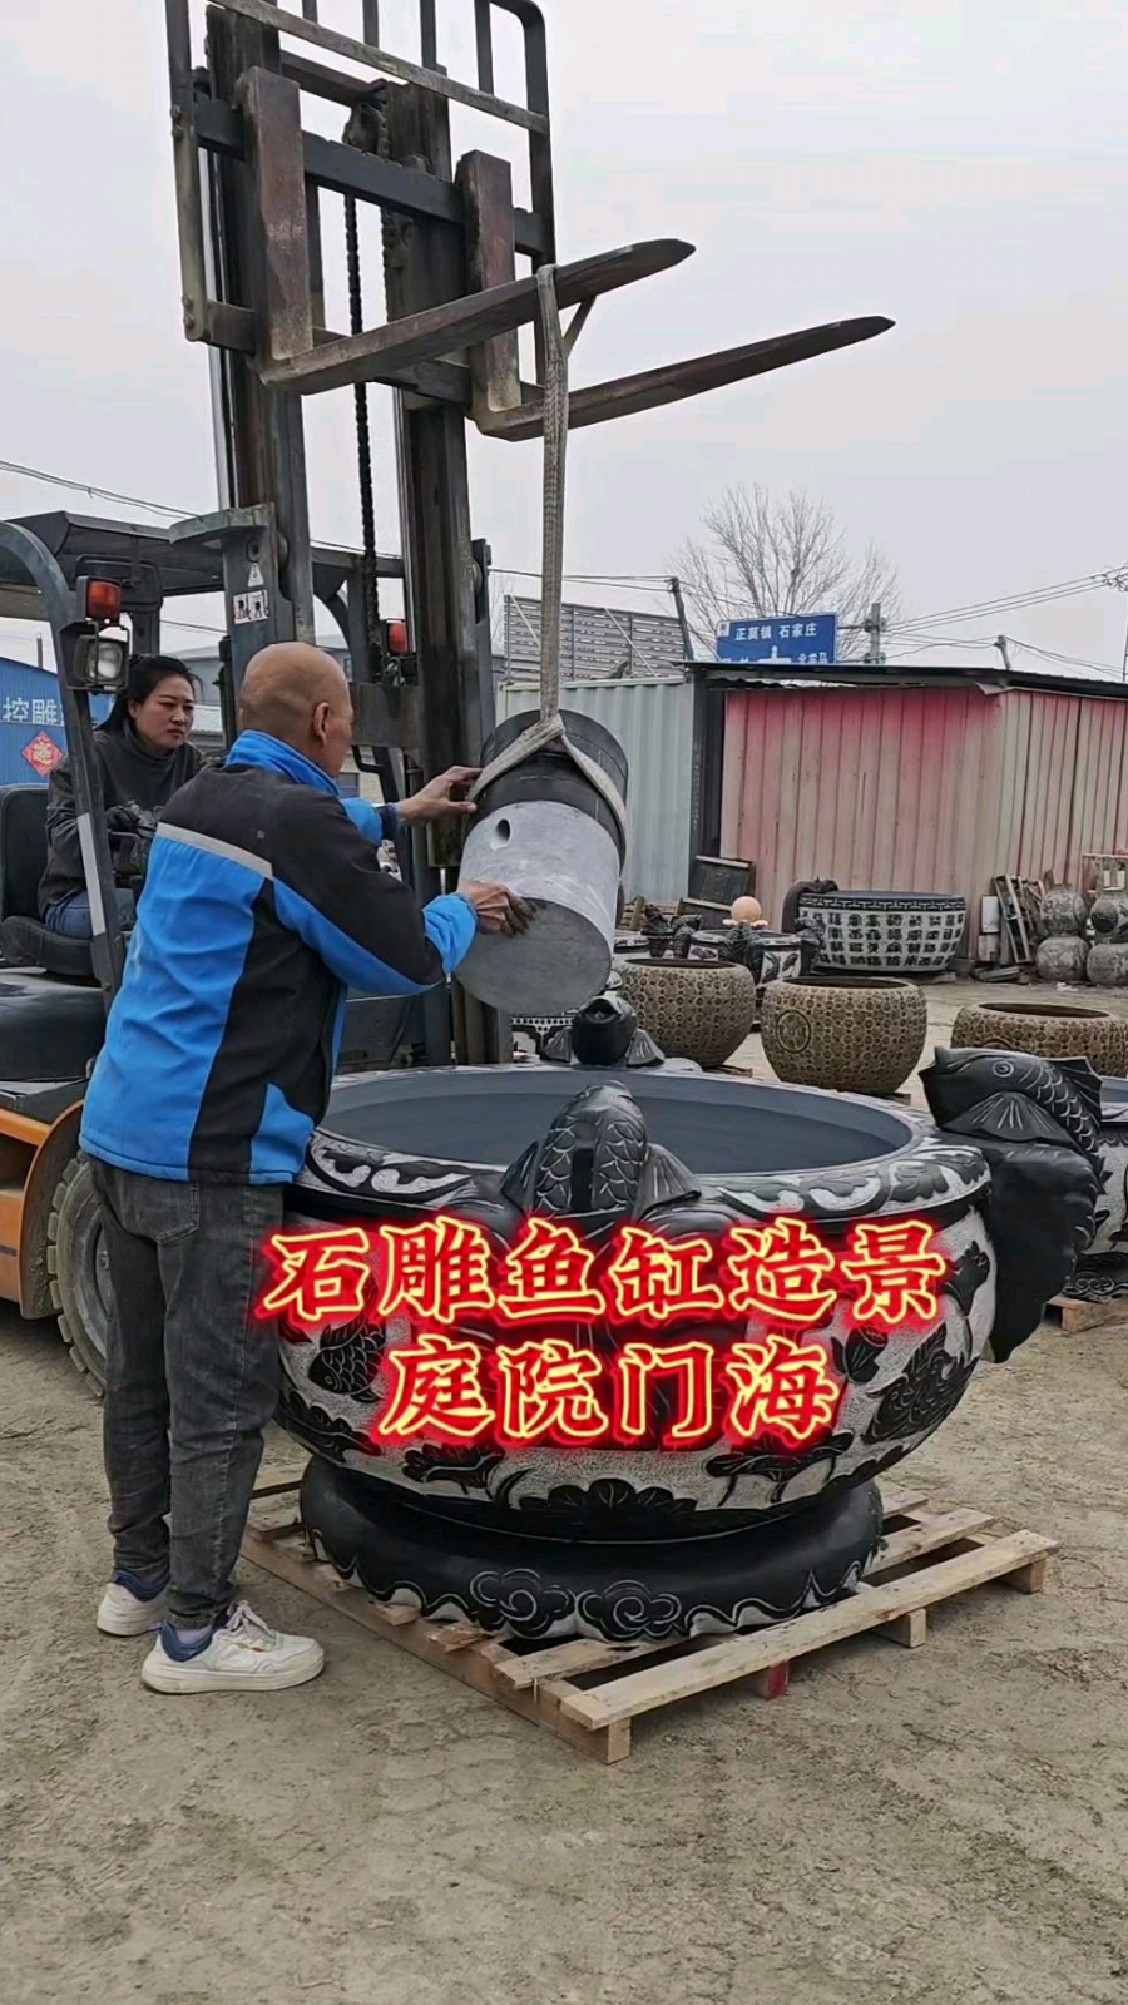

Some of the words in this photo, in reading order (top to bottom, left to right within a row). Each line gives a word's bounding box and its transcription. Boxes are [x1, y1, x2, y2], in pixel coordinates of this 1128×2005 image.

[779, 622, 818, 639] 石家庄
[3, 697, 65, 727] 控雕
